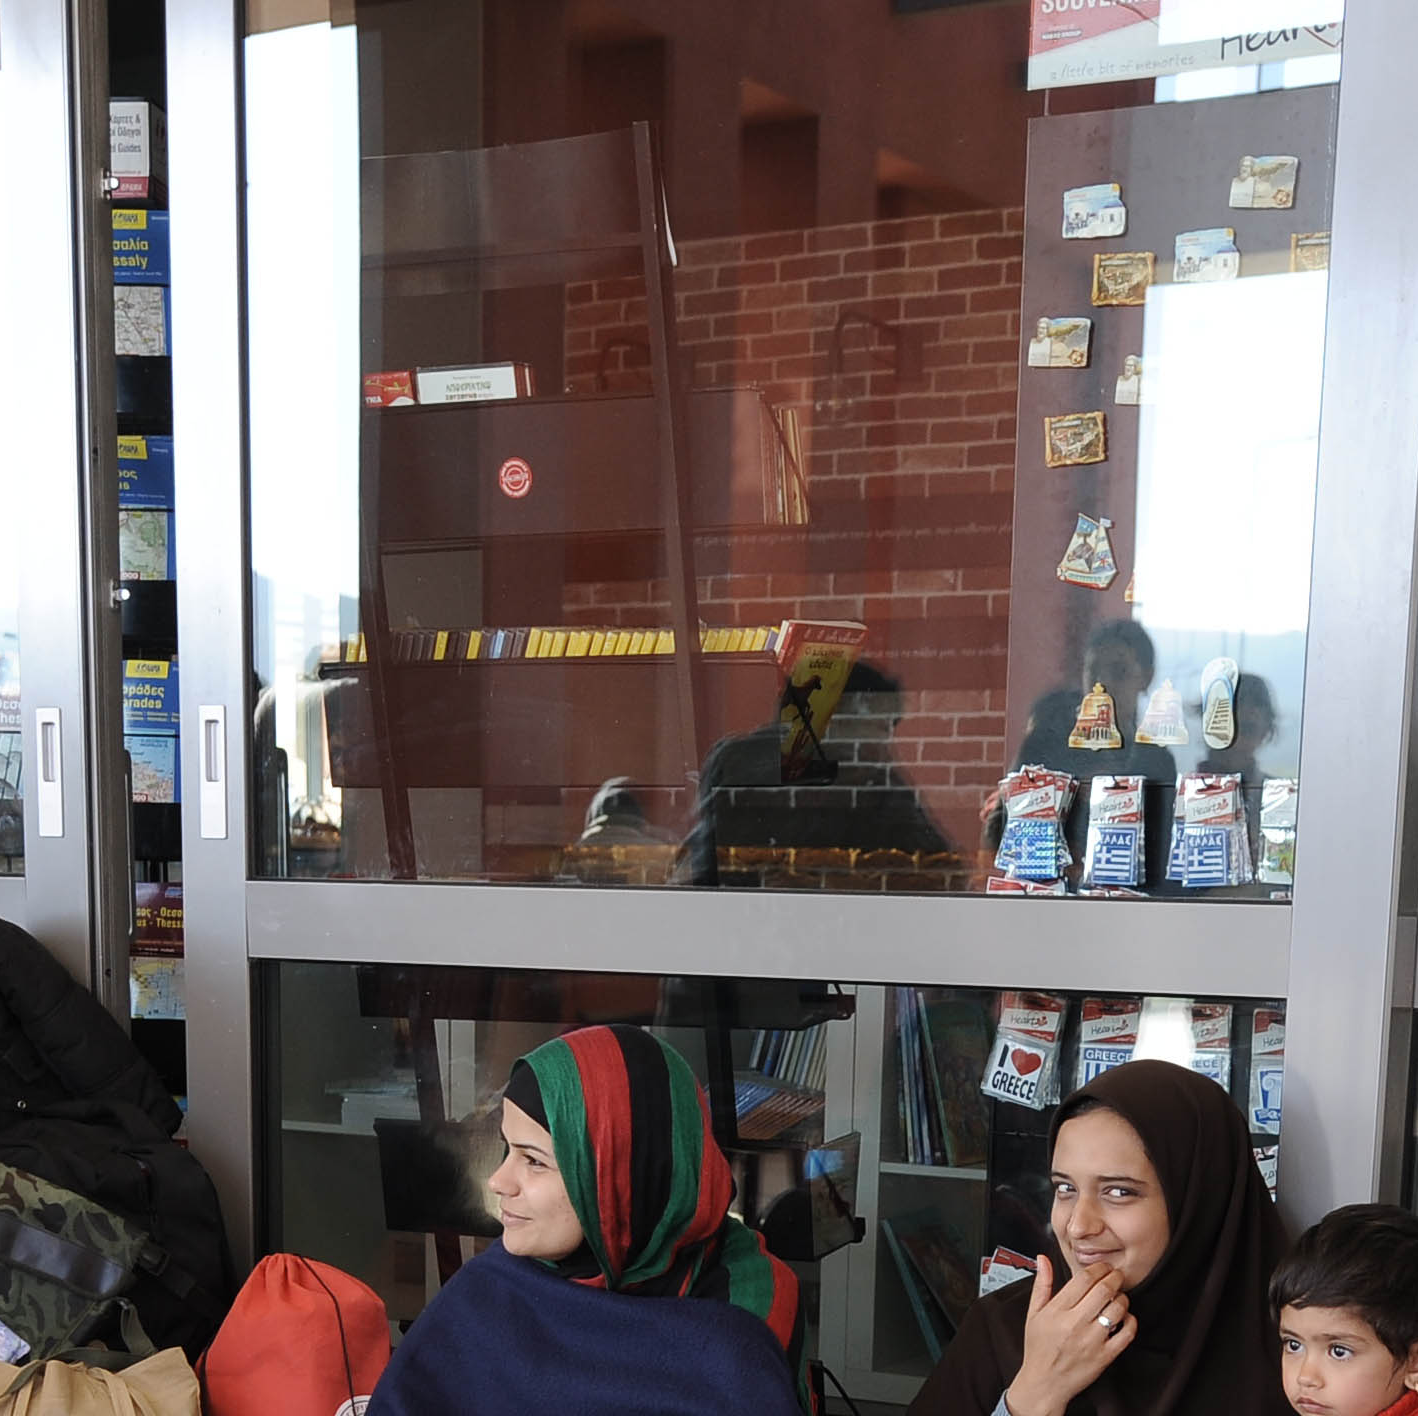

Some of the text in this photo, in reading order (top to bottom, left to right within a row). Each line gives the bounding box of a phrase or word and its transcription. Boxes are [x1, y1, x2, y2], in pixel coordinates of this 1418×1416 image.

[112, 237, 149, 250] σαλία
[112, 254, 148, 270] ssaly
[1262, 1035, 1284, 1047] Hear
[998, 1044, 1009, 1068] I
[992, 1070, 1035, 1100] GREECE
